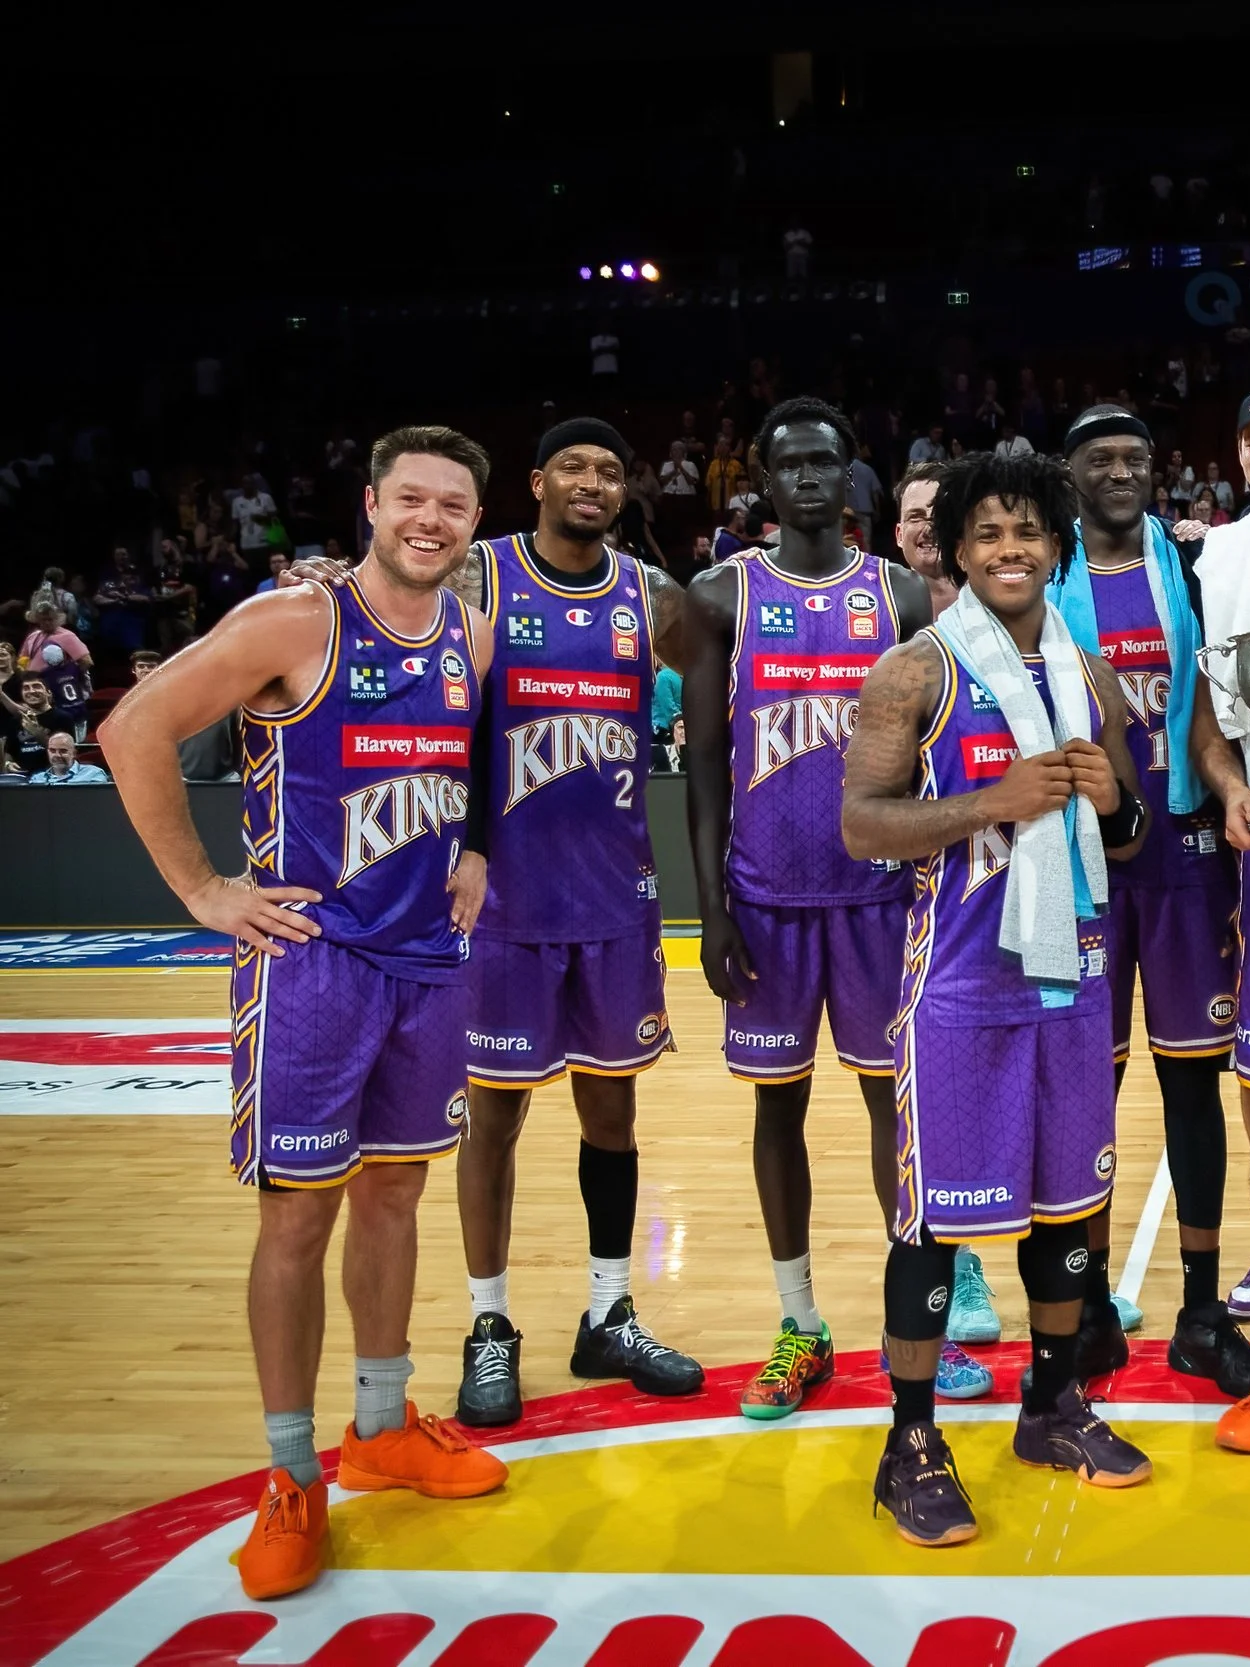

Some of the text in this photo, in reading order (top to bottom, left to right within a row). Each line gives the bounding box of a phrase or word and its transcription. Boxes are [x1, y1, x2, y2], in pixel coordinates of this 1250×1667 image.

[852, 596, 870, 608] NBL
[1121, 638, 1166, 654] Norm
[763, 664, 873, 681] Harvey Norma
[350, 691, 388, 699] HOSTPLUS
[518, 678, 631, 699] Harvey Norman
[355, 736, 466, 755] Harvey Norman
[973, 746, 1018, 764] Harv
[503, 714, 639, 816] KINGS
[614, 769, 634, 809] 2
[337, 773, 469, 889] KINGS
[1215, 1003, 1232, 1017] NBL
[728, 1028, 800, 1048] remara.
[103, 1076, 224, 1090] for
[271, 1128, 350, 1152] remara.
[927, 1186, 1013, 1206] remara.
